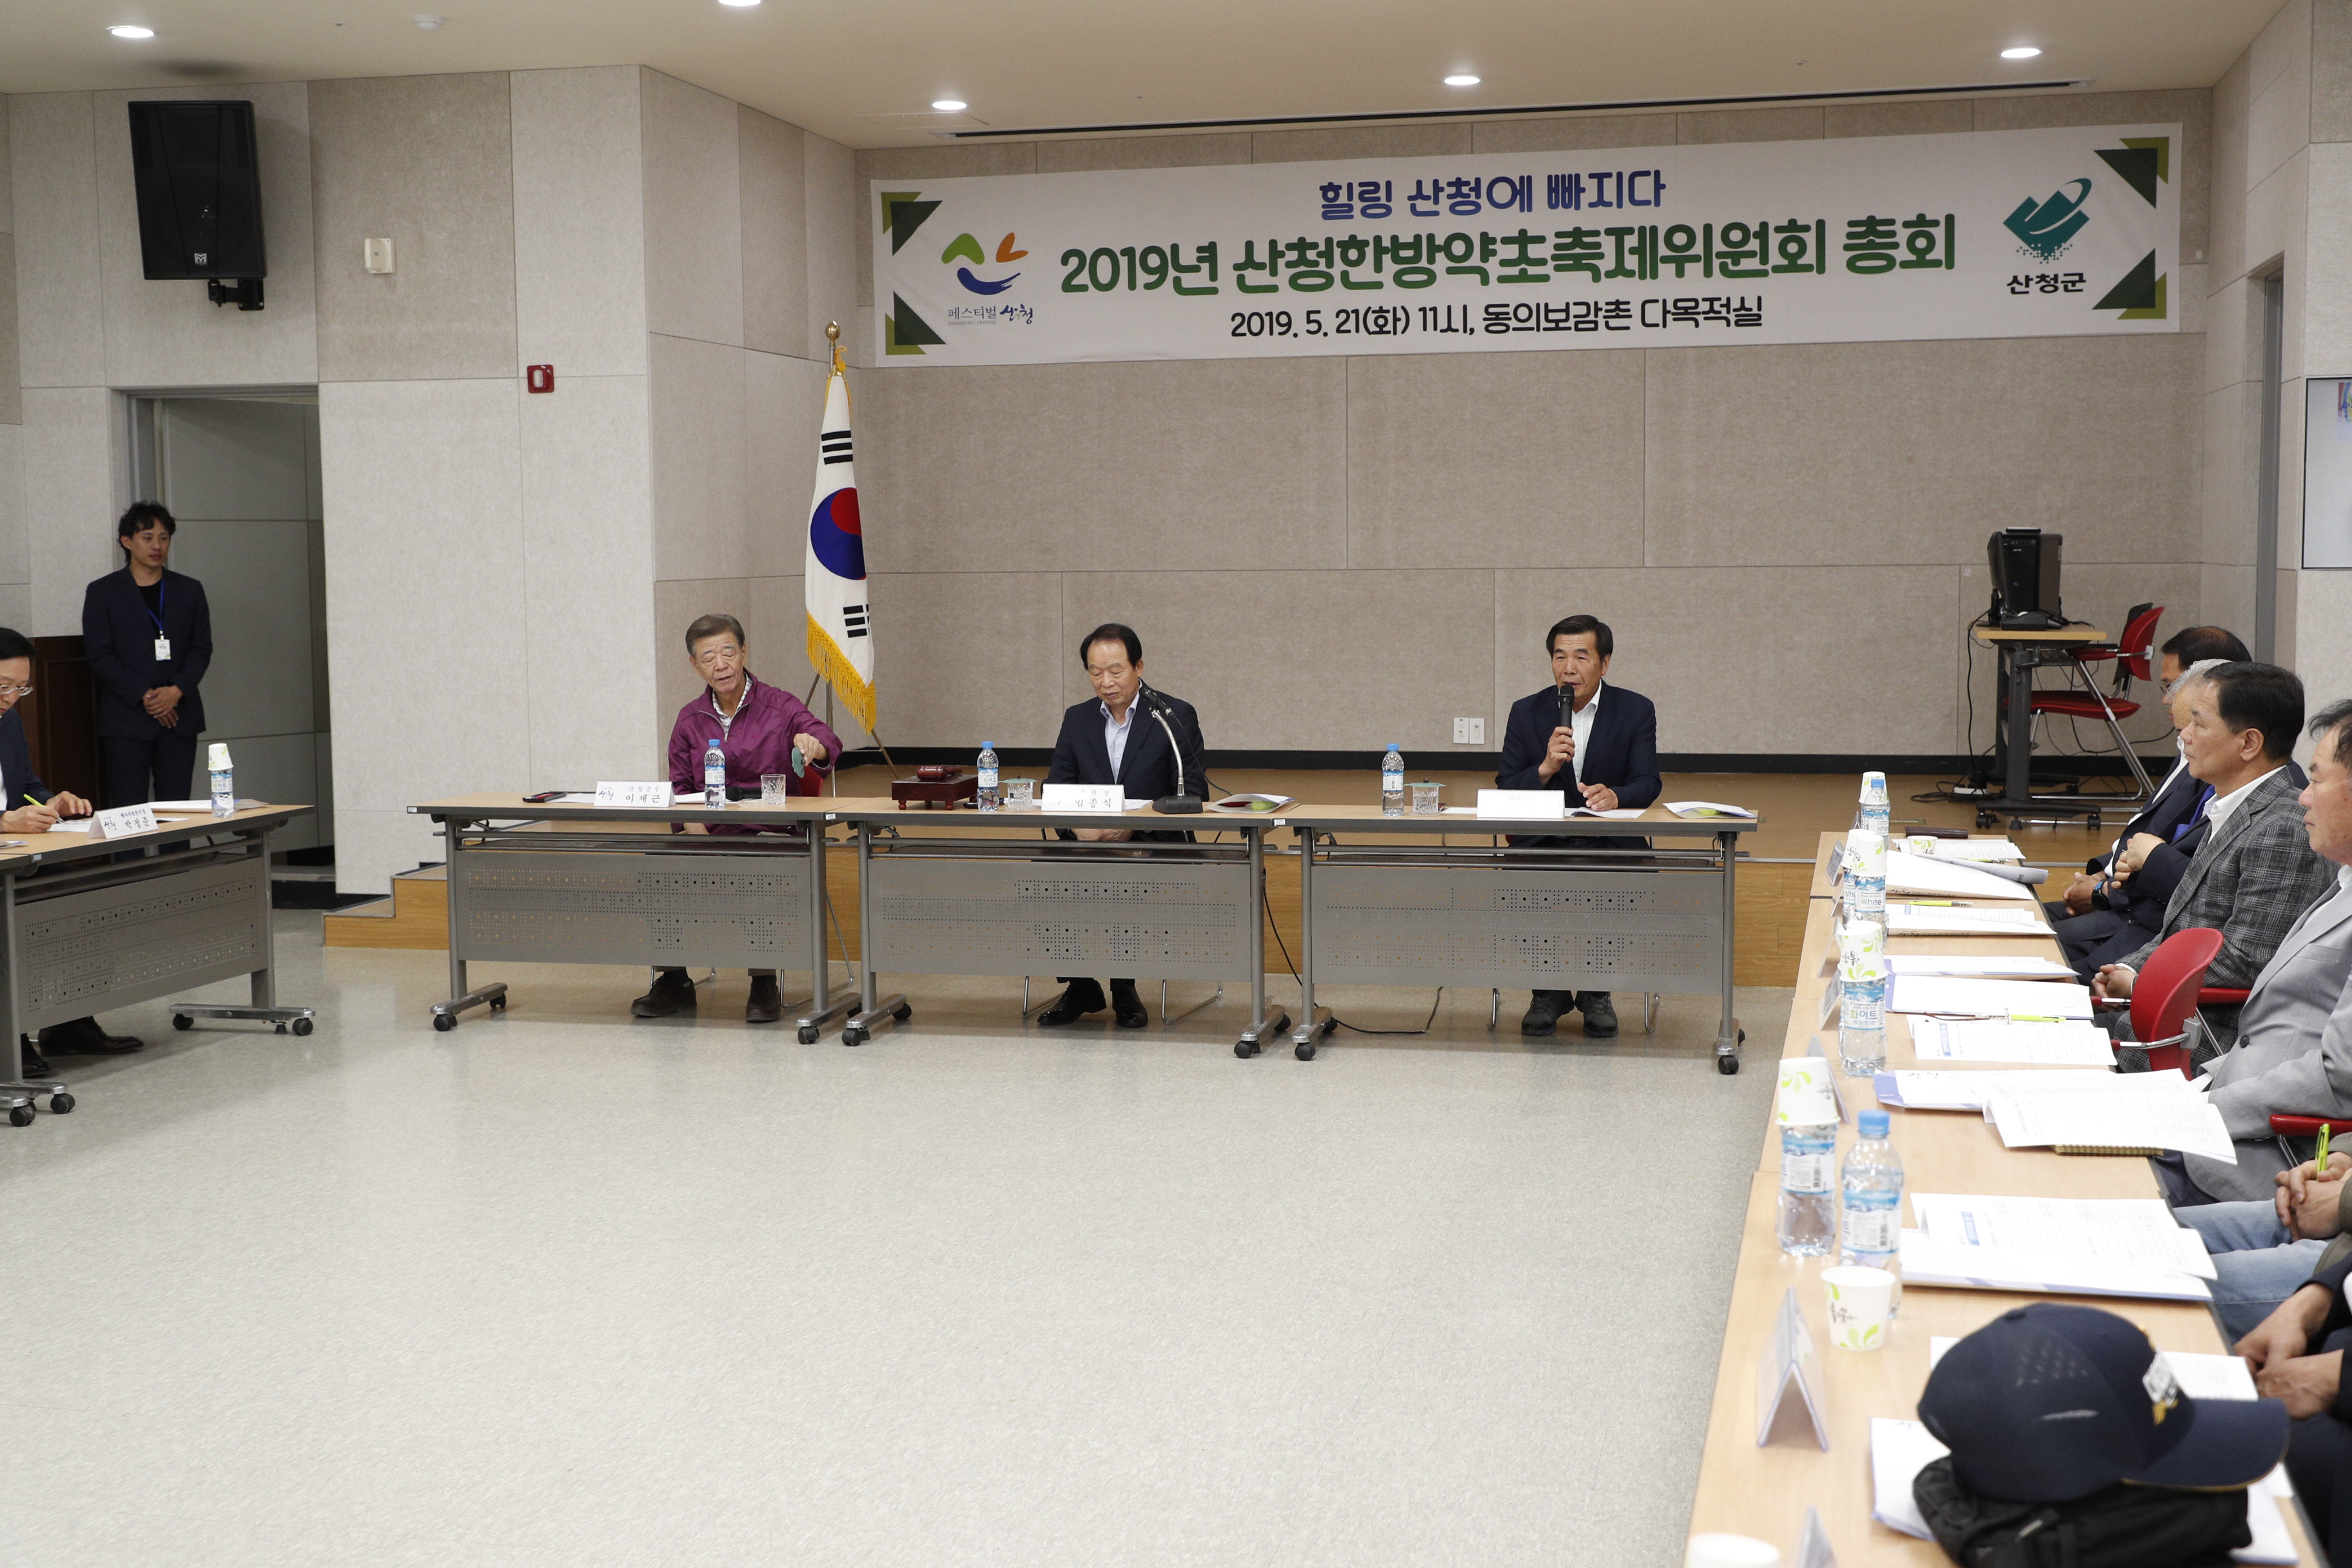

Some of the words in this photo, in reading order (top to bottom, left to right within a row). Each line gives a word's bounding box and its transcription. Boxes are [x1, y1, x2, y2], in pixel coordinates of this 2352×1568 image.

[1319, 181, 1392, 220] 힐링
[1407, 175, 1533, 217] 산청에
[1547, 169, 1667, 211] 빠지다
[1061, 241, 1219, 297] 2019년
[1232, 219, 1827, 295] 산청한방약초축제위원회
[1842, 213, 1955, 275] 총회
[2006, 272, 2087, 295] 산청군
[948, 306, 997, 320] 페스티벌
[999, 303, 1034, 324] 산청
[1231, 310, 1298, 338] 2019.
[1306, 310, 1329, 338] 5.
[1335, 306, 1411, 336] 21(화)
[1418, 304, 1475, 336] 11시,
[1482, 302, 1632, 335] 동의보감촌
[1640, 296, 1763, 329] 다목적실
[1861, 897, 1882, 906] White
[1850, 1009, 1877, 1020] 화이트
